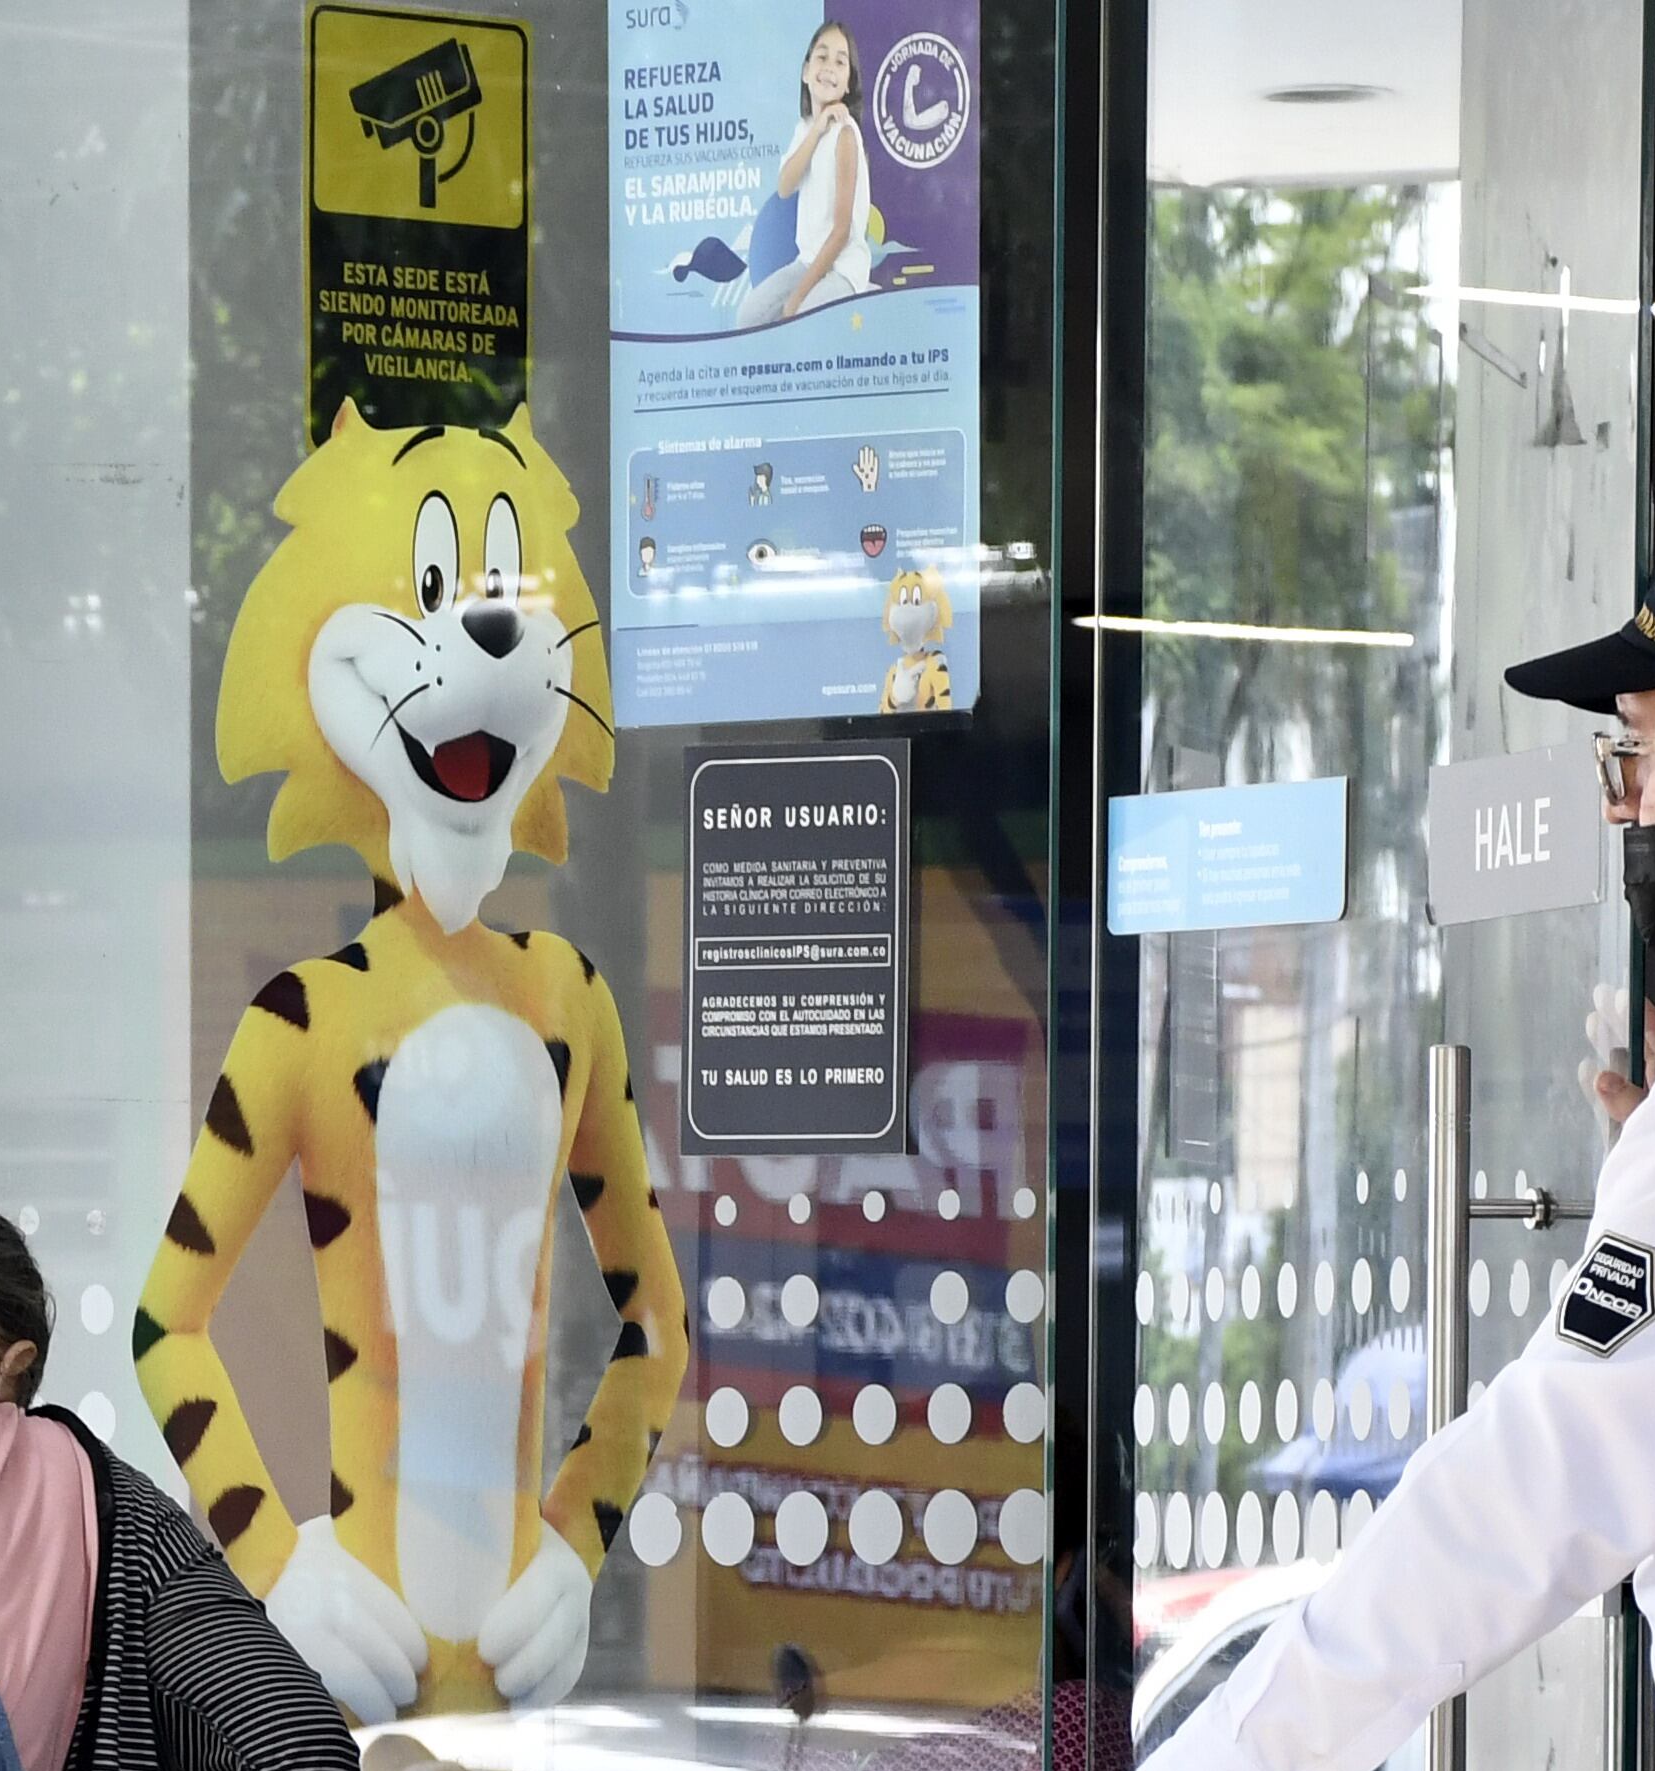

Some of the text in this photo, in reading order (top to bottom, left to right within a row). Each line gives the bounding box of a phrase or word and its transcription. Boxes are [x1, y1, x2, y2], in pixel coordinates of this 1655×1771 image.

[626, 6, 671, 29] sura
[890, 41, 939, 73] JORNADA
[937, 51, 955, 71] DE
[624, 60, 721, 90] REFUERZA
[624, 92, 714, 120] LA SALUD
[625, 118, 754, 151] DE TUS HIJOS,
[880, 110, 962, 161] VACUNACIÓN
[624, 144, 780, 169] REFUERZA SUS VACUNAS CONTRA
[625, 161, 761, 200] EL SARAMPIÓN
[624, 191, 758, 227] Y LA RUBÉOLA.
[343, 261, 490, 296] ESTA SEDE ESTÁ
[319, 289, 519, 328] SIENDO MONITOREADA
[342, 321, 496, 356] POR CÁMARAS DE
[364, 352, 476, 383] VIGILANCIA.
[639, 348, 949, 385] Agenda la cita en epssura.com o llamando a tu IPS
[703, 803, 886, 830] SEÑOR USUARIO:
[1475, 797, 1551, 872] HALE
[702, 901, 887, 916] LA SIGUIENTE DIRECCIÓN:
[701, 1067, 885, 1086] TU SALUD ES LO PRIMERO
[1588, 1262, 1637, 1291] PRIVADA
[1593, 1251, 1645, 1279] SEGURIDAD
